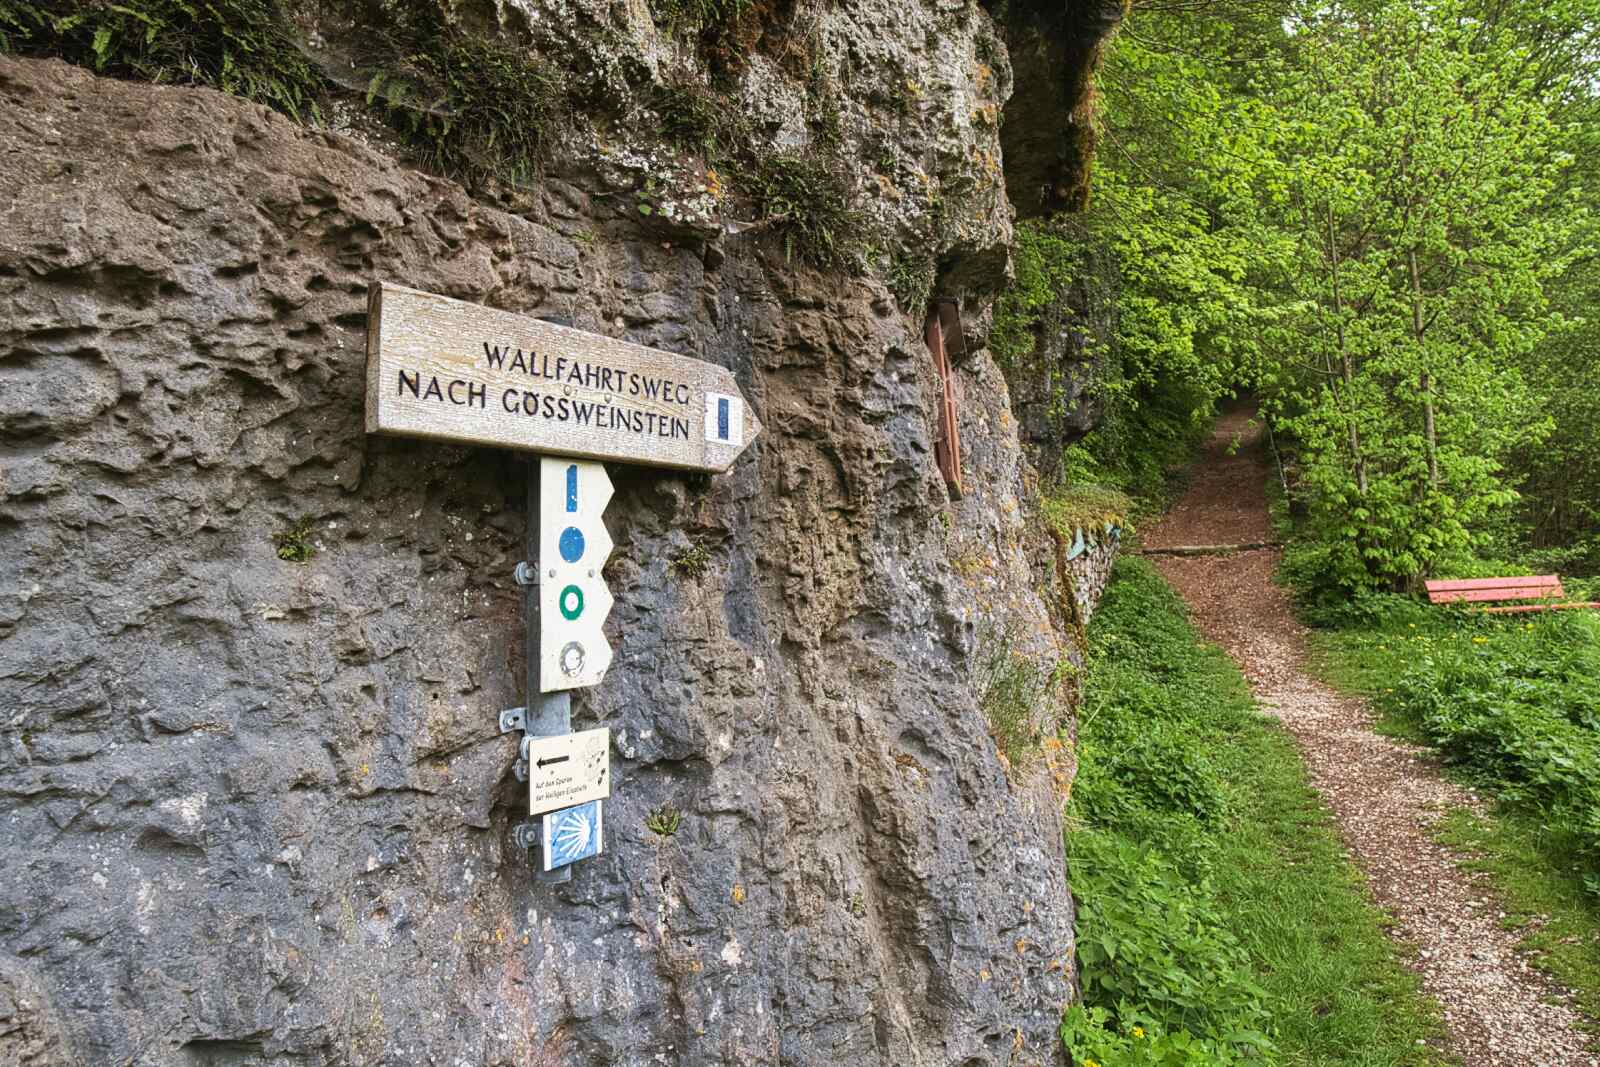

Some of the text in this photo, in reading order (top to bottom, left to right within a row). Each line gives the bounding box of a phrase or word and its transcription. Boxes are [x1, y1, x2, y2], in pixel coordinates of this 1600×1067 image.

[398, 369, 690, 440] NACH GÖSSWEINSTEIN
[483, 341, 690, 406] WALLFAHRTSWEG
[535, 781, 545, 789] Auf
[555, 776, 573, 787] Spuren
